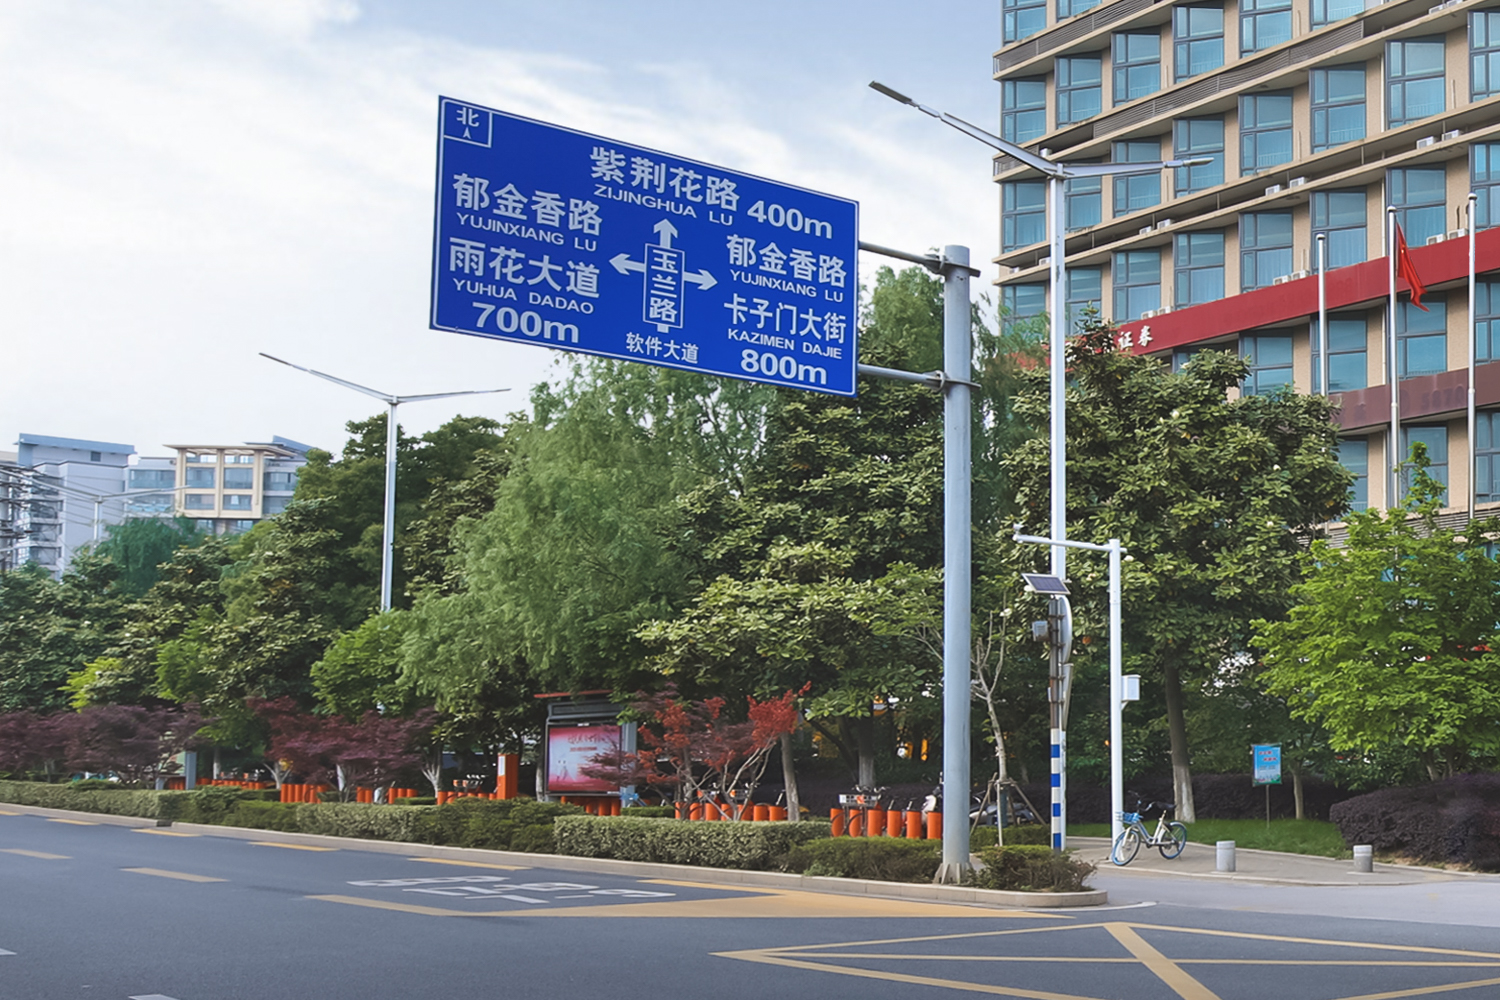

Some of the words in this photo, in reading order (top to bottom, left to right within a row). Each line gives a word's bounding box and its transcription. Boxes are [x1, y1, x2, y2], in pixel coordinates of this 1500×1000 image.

[456, 107, 479, 127] 北
[589, 146, 740, 211] 紫荆花路
[452, 173, 603, 236] 郁金香路
[593, 184, 697, 218] ZIJINGHUA
[709, 211, 733, 226] LU
[747, 200, 833, 239] 400m
[456, 212, 565, 245] YUJINXIANG
[574, 236, 597, 252] LU
[449, 236, 600, 299] 雨花大道
[726, 234, 847, 288] 郁金香路
[453, 278, 518, 301] YUHUA
[529, 292, 594, 315] DADAO
[649, 249, 679, 323] 玉兰路
[730, 269, 817, 298] YUJINXIANG
[825, 289, 844, 303] LU
[472, 301, 579, 344] 700m
[724, 293, 847, 344] 卡子门大街
[626, 332, 699, 364] 软件大道
[728, 328, 795, 351] KAZIMEN
[802, 342, 842, 360] DAJIE
[741, 349, 827, 385] 800m
